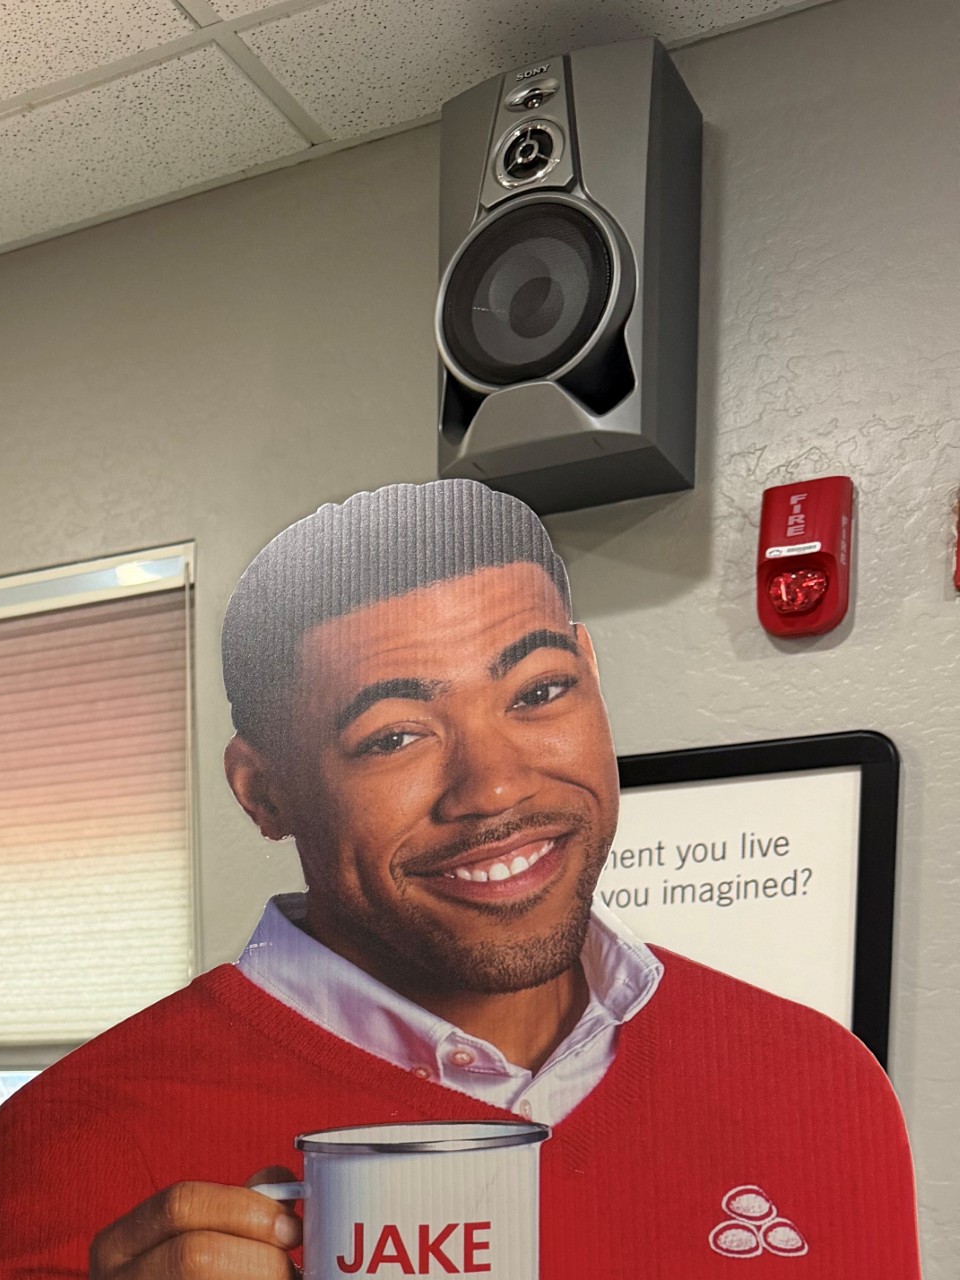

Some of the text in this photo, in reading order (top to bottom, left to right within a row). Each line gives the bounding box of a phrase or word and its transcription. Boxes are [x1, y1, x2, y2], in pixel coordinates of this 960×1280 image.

[515, 64, 550, 81] SONY
[786, 494, 807, 537] FIRE
[675, 840, 728, 870] you
[741, 832, 790, 860] live
[662, 867, 813, 908] imagined?
[336, 1221, 492, 1275] JAKE
